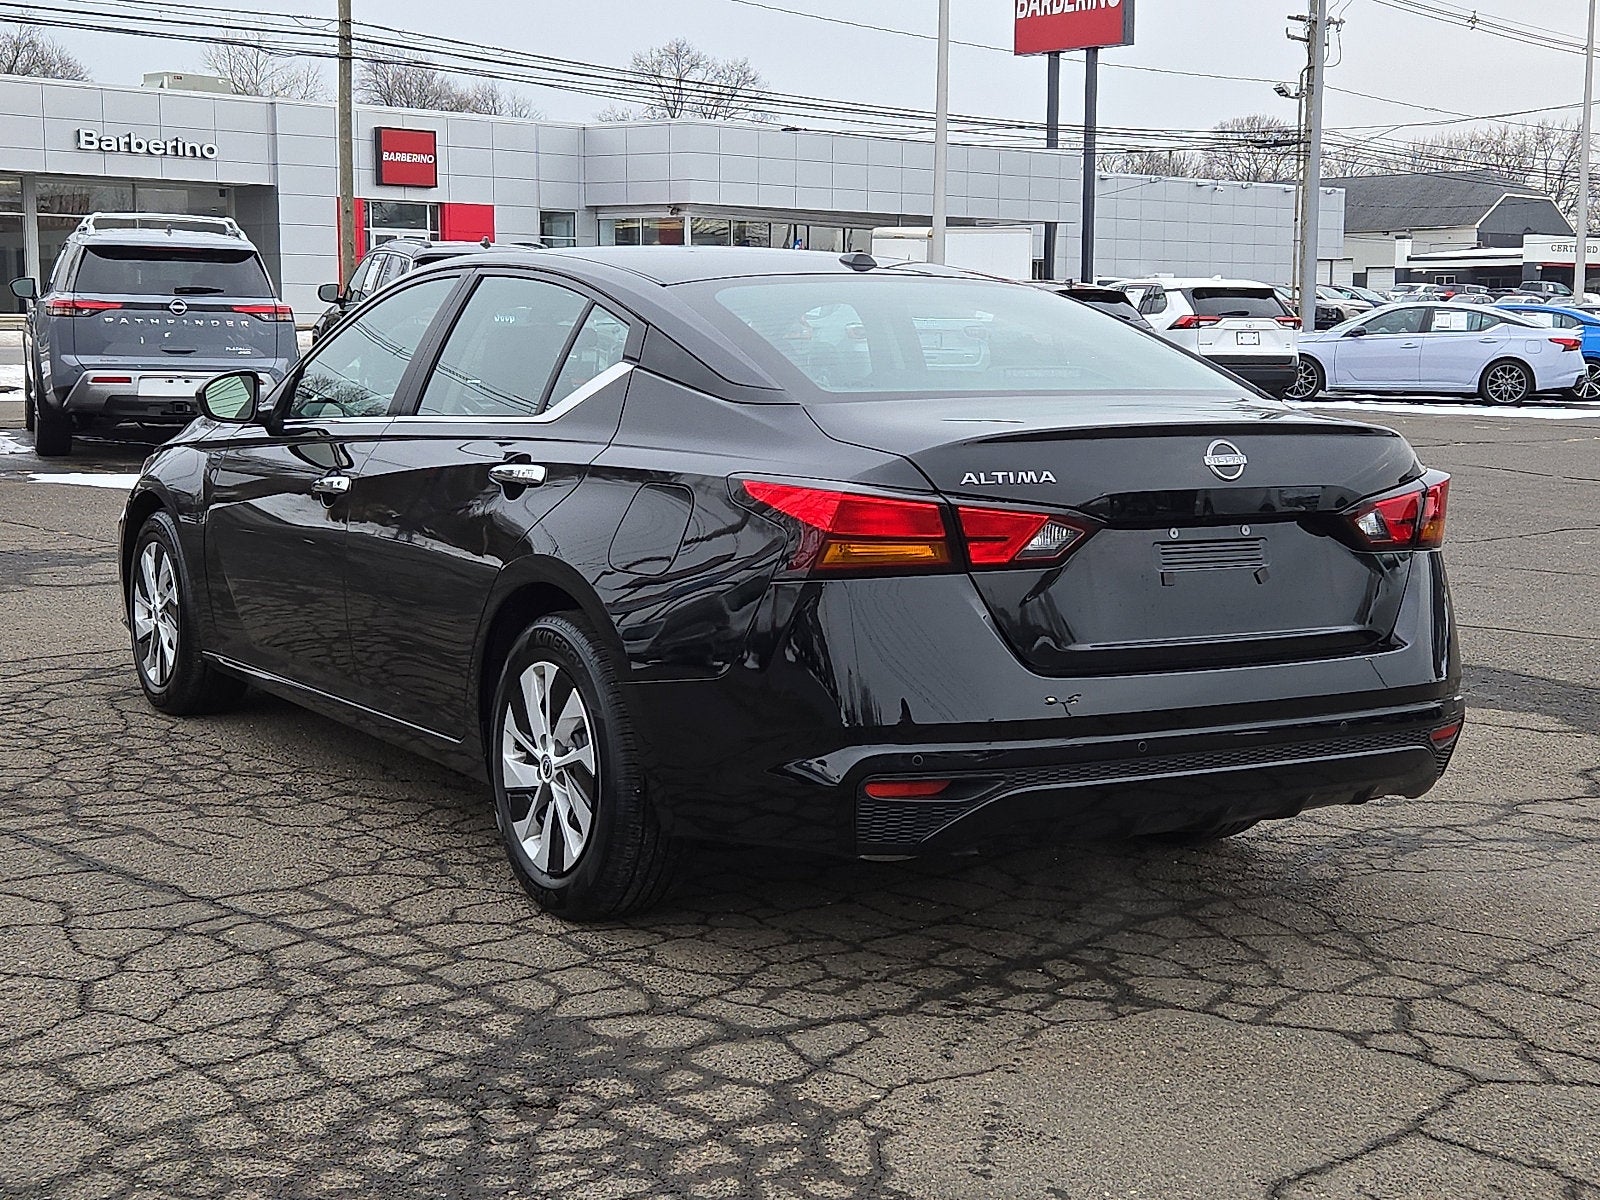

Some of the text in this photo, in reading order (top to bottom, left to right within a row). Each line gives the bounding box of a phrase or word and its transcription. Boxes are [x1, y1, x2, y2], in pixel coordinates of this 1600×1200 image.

[77, 128, 219, 158] Barberino
[382, 151, 435, 164] BARBERINO
[1551, 244, 1598, 253] CERTIED
[104, 317, 249, 327] PATHFINDER
[1206, 455, 1246, 464] NISSAN
[960, 470, 1057, 485] ALTIMA
